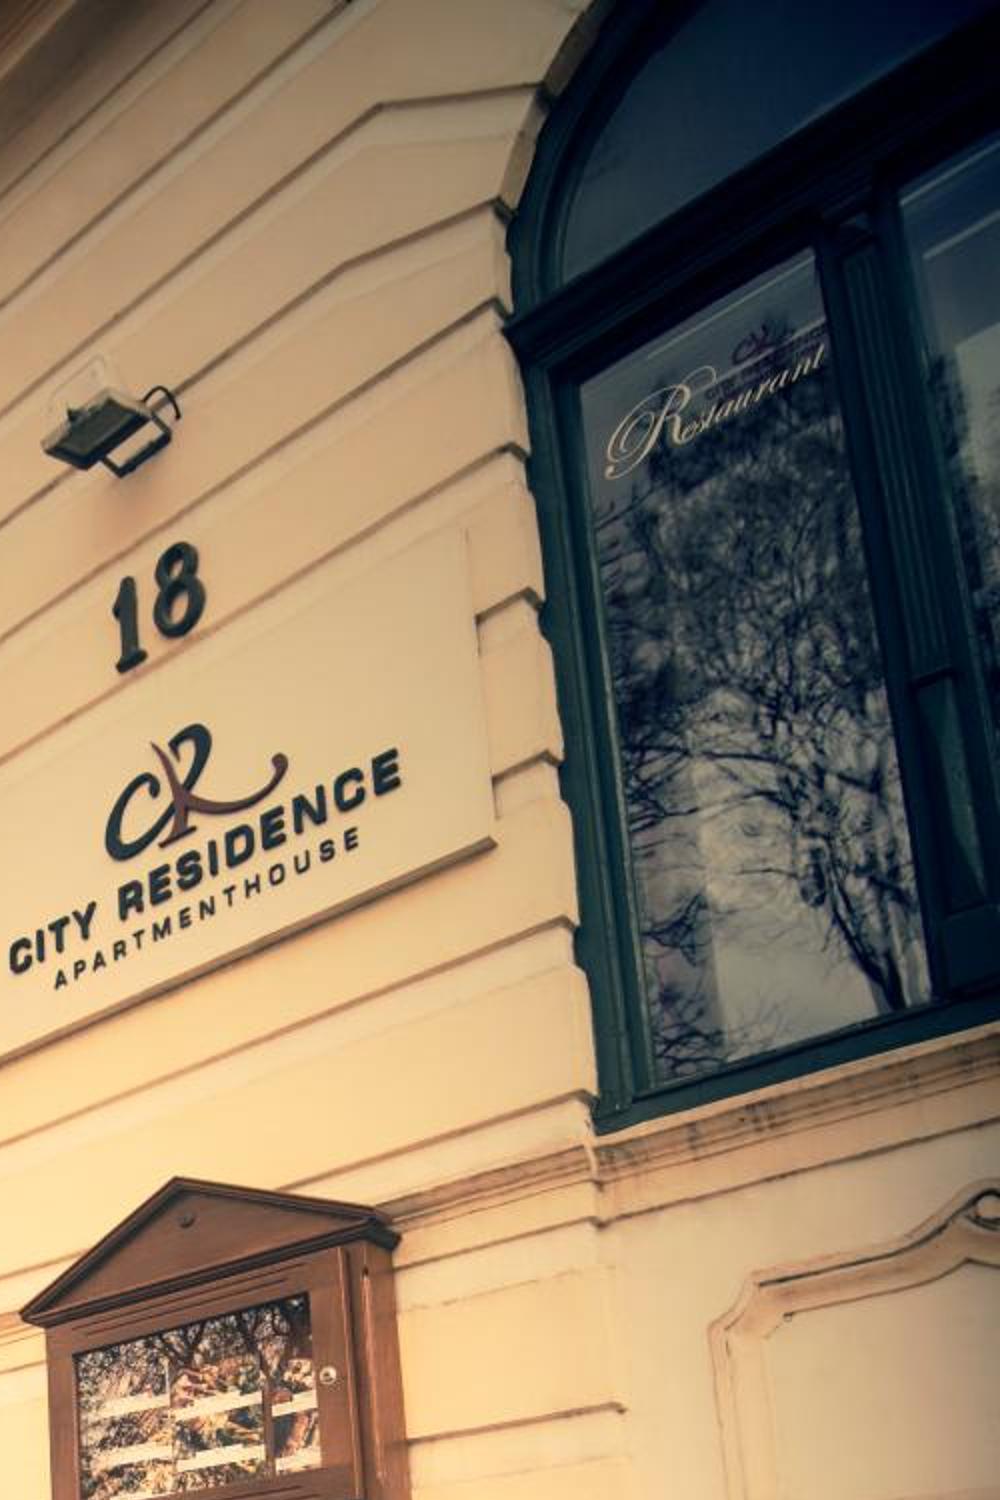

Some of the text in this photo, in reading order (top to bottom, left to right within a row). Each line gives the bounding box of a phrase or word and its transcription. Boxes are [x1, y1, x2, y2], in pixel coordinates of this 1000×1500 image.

[604, 344, 825, 480] Restaurant
[112, 541, 207, 673] 18
[8, 747, 403, 976] CITY RESIDENCE
[53, 826, 361, 991] APARTMENTHOUSE
